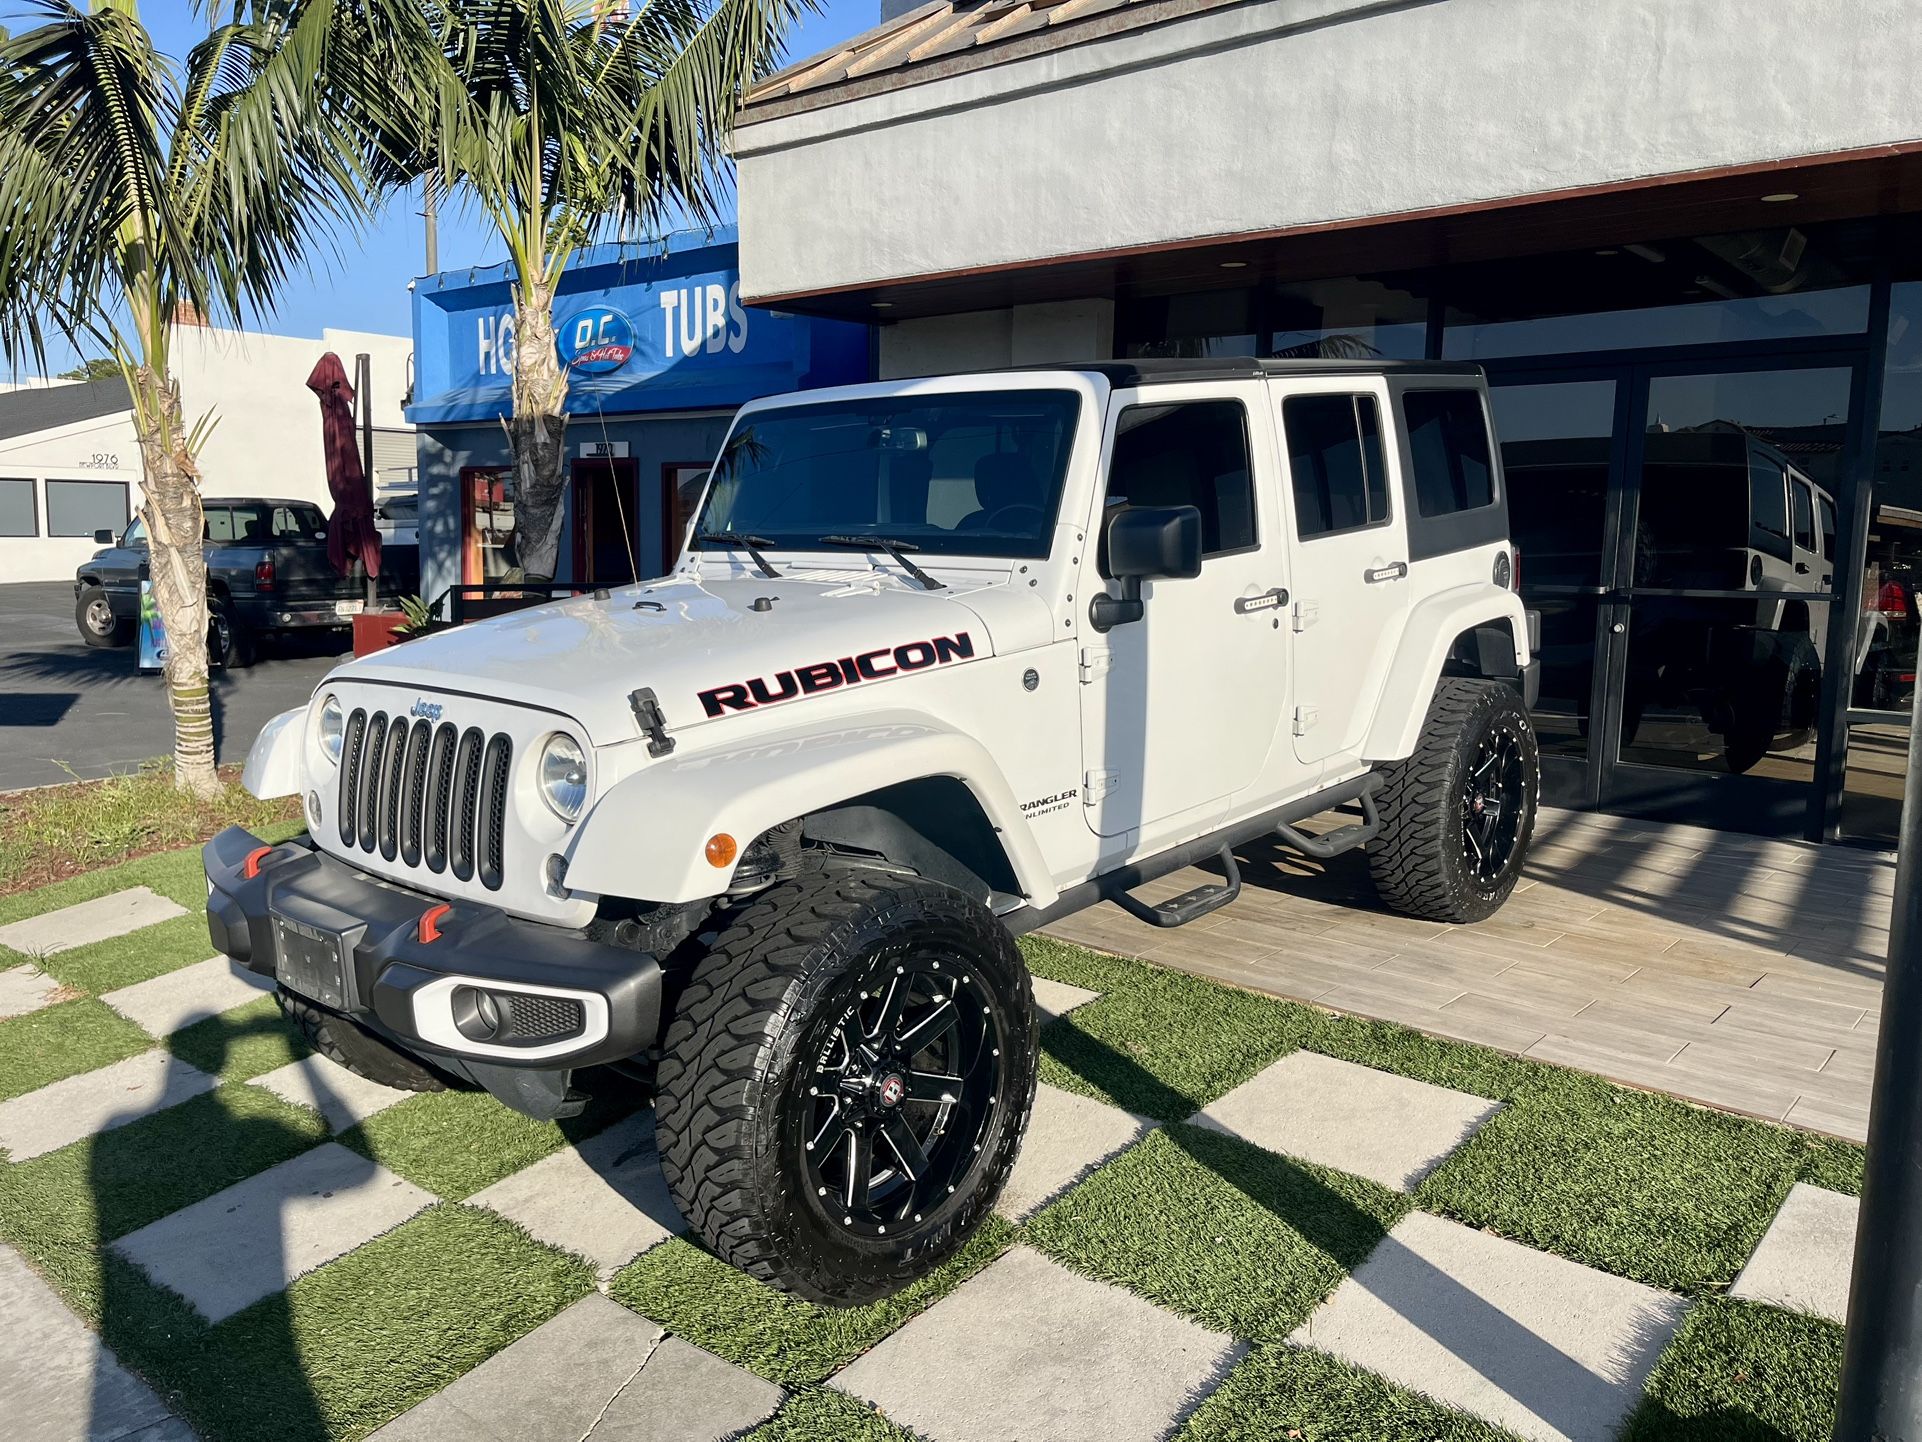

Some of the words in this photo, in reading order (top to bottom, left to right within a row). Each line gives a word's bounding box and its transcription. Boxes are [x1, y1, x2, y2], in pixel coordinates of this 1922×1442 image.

[478, 313, 519, 375] HO
[660, 281, 748, 357] TUBS
[575, 315, 616, 349] O.C.
[92, 453, 119, 465] 1976
[697, 632, 975, 718] RUBICON
[410, 697, 442, 724] Jeep
[1020, 789, 1077, 811] RANGLER
[1025, 802, 1070, 820] NLIMITED
